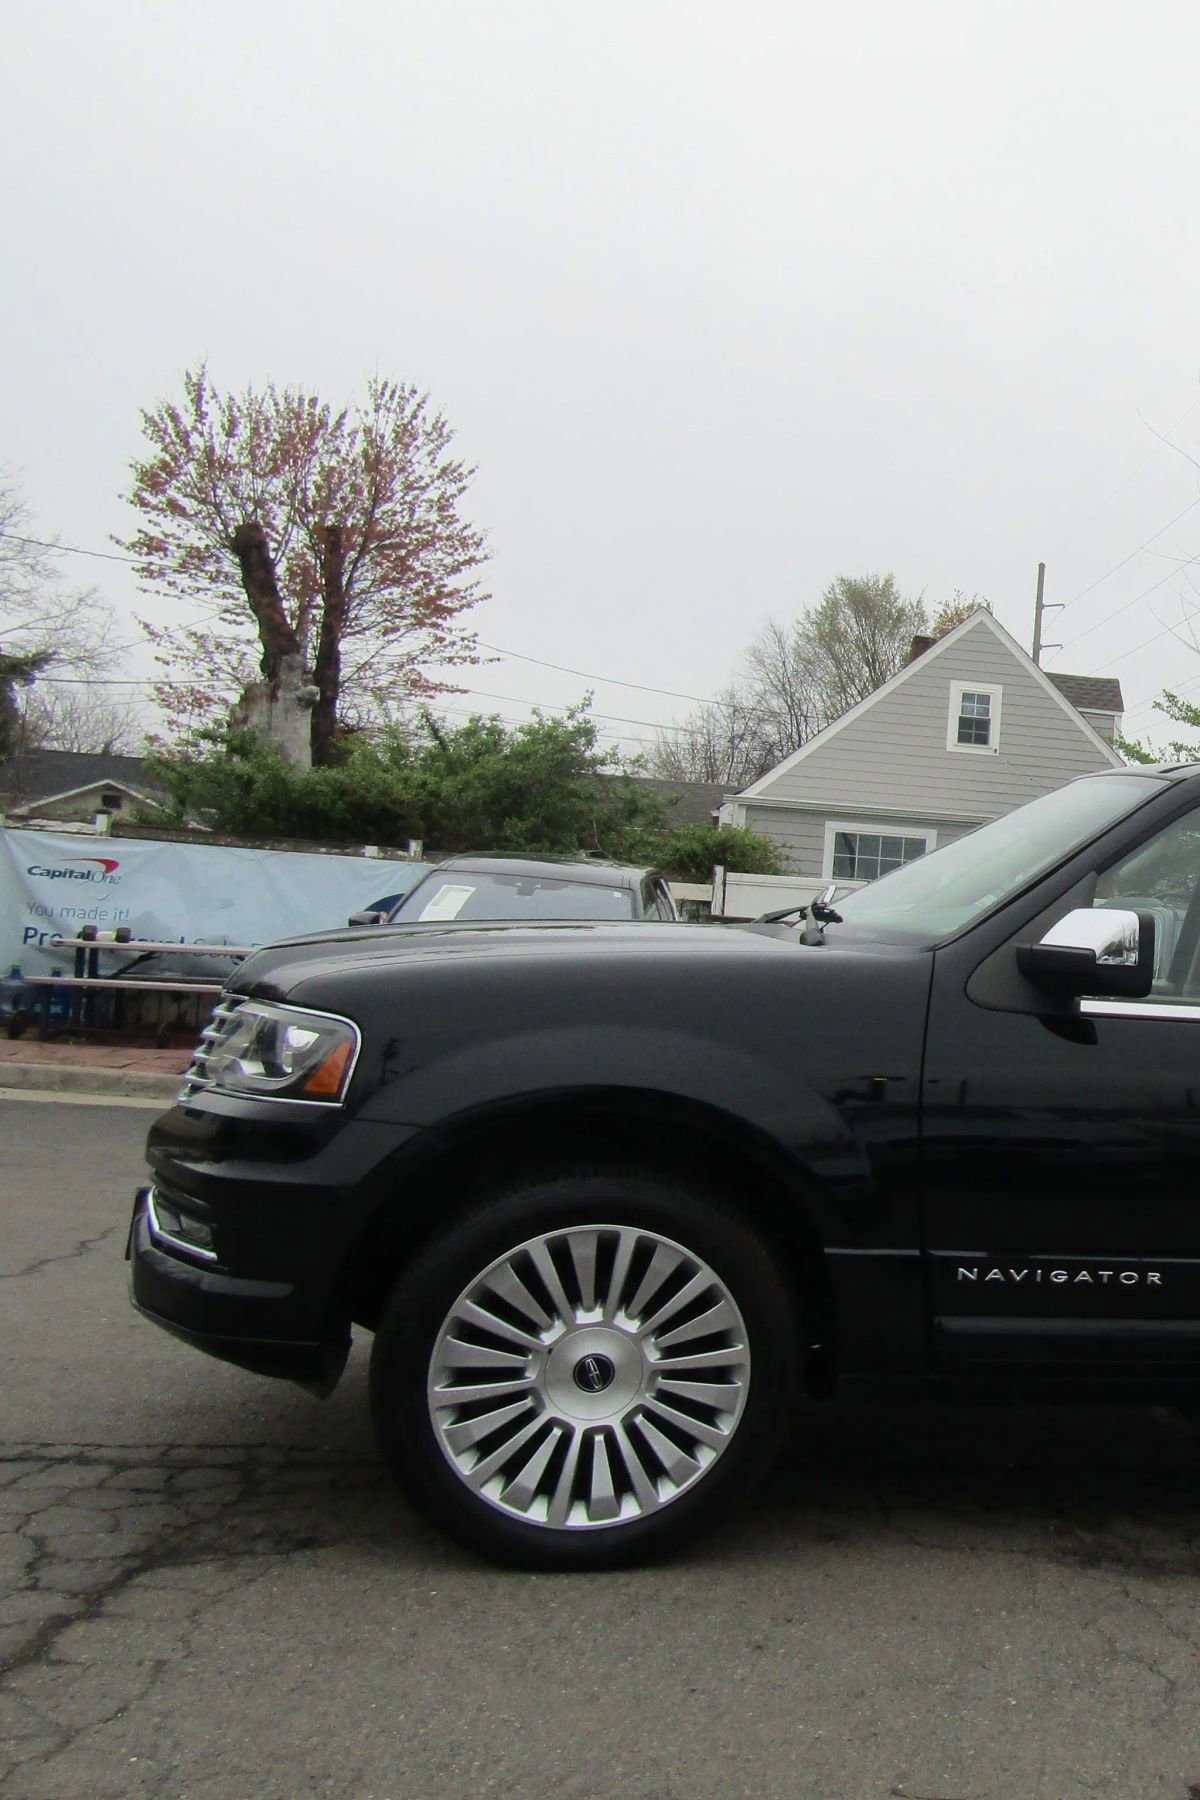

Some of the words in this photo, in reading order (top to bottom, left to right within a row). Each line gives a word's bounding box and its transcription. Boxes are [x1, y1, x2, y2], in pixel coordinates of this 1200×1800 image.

[26, 902, 54, 918] You
[60, 906, 108, 921] made
[113, 908, 130, 922] it!
[956, 1267, 1162, 1285] NAVIGATOR
